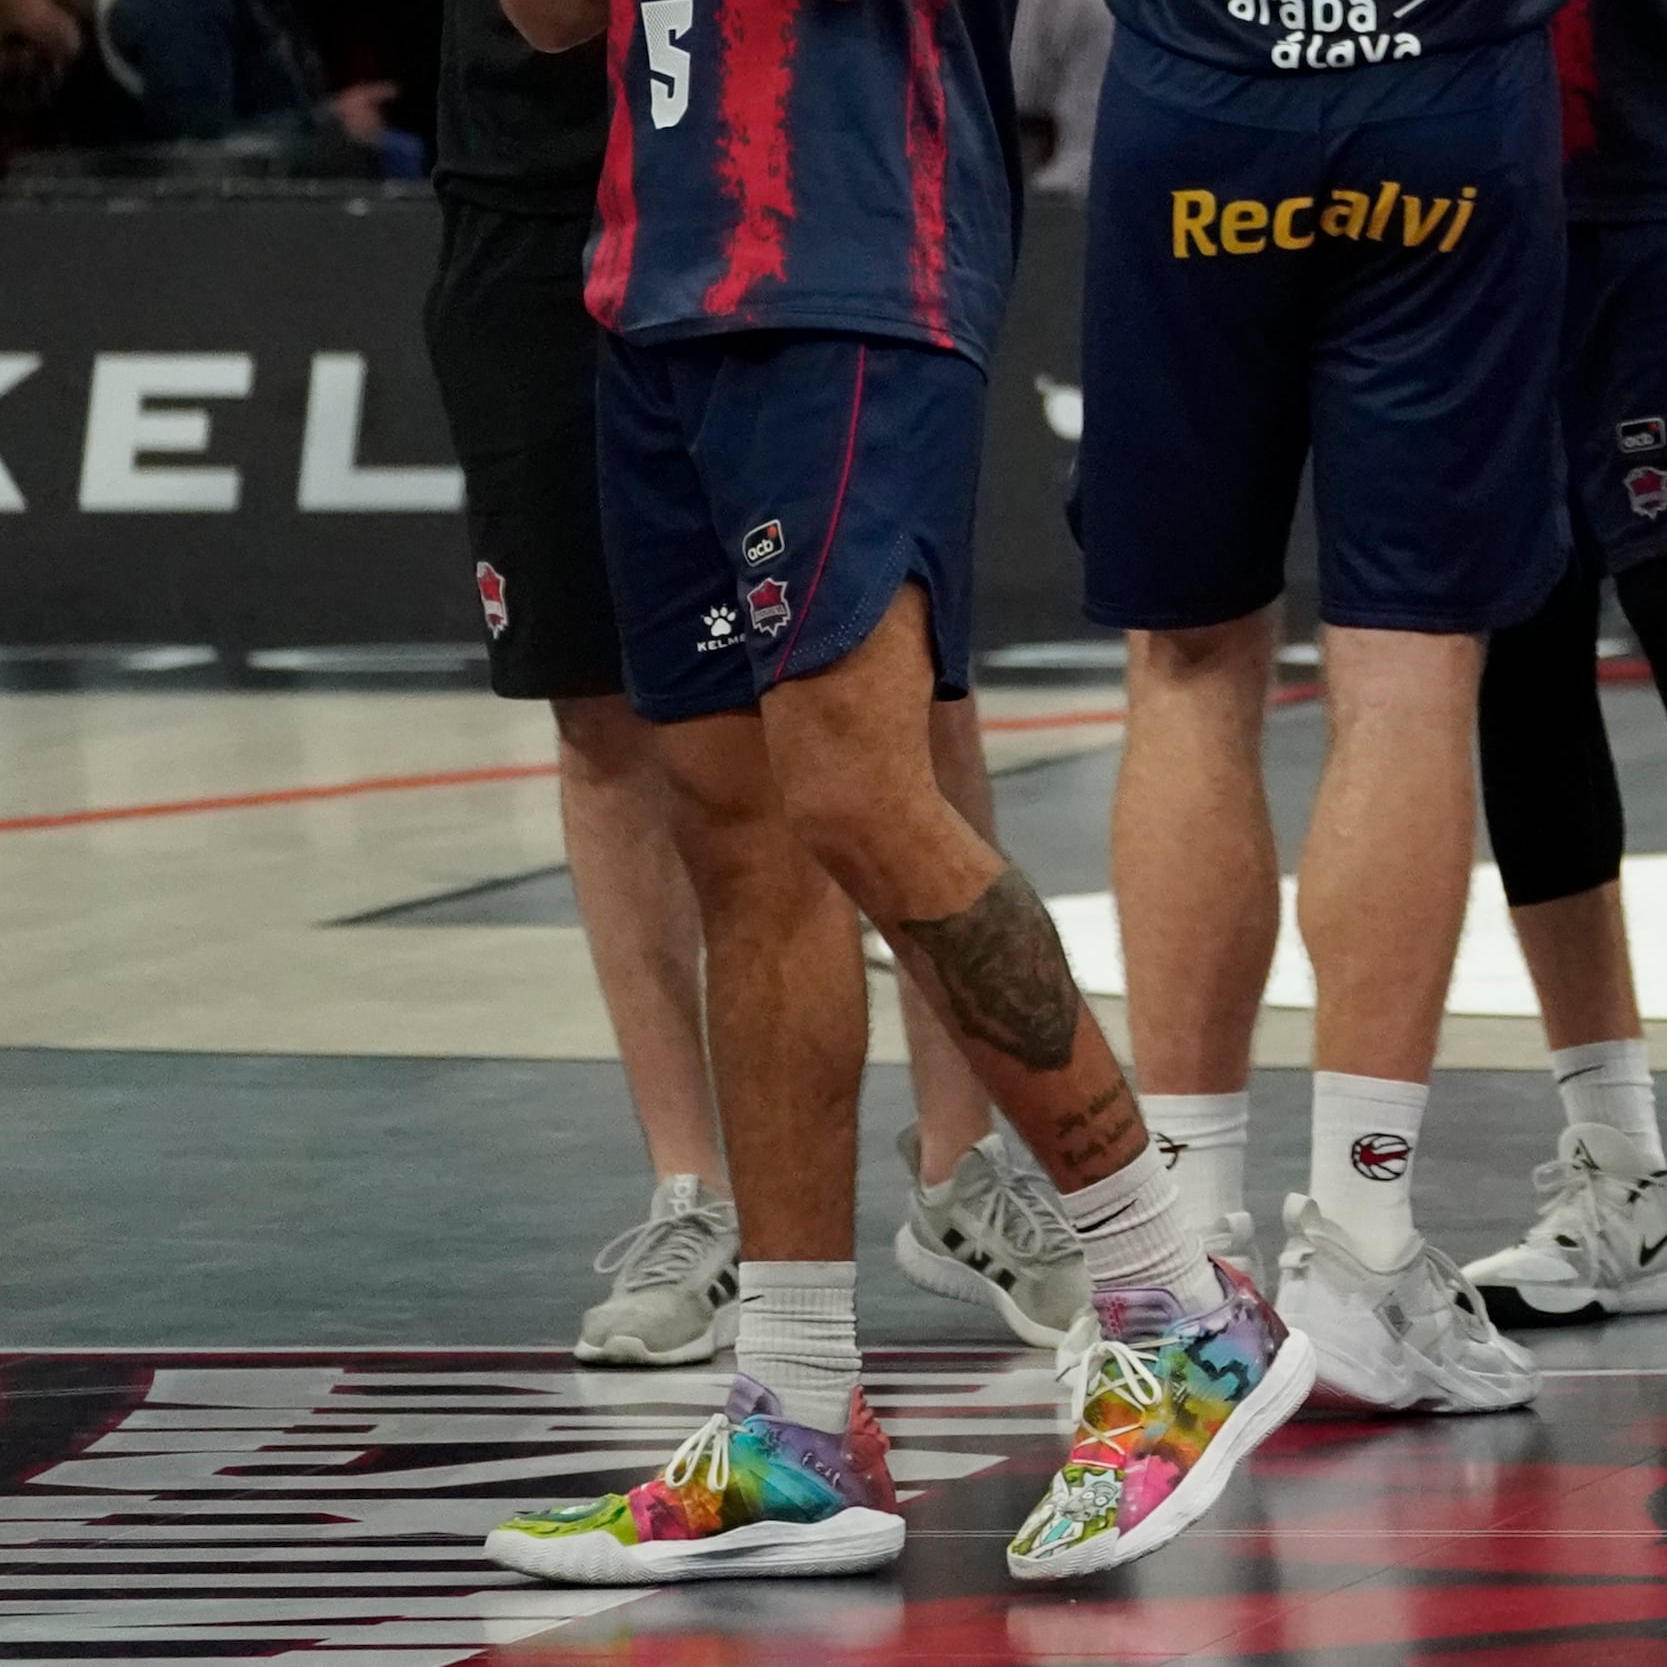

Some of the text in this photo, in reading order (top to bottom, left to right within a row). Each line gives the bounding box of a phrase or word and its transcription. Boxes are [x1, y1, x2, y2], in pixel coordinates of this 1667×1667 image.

[1170, 181, 1478, 260] Recalvi
[0, 350, 466, 513] EL
[747, 538, 774, 561] acb
